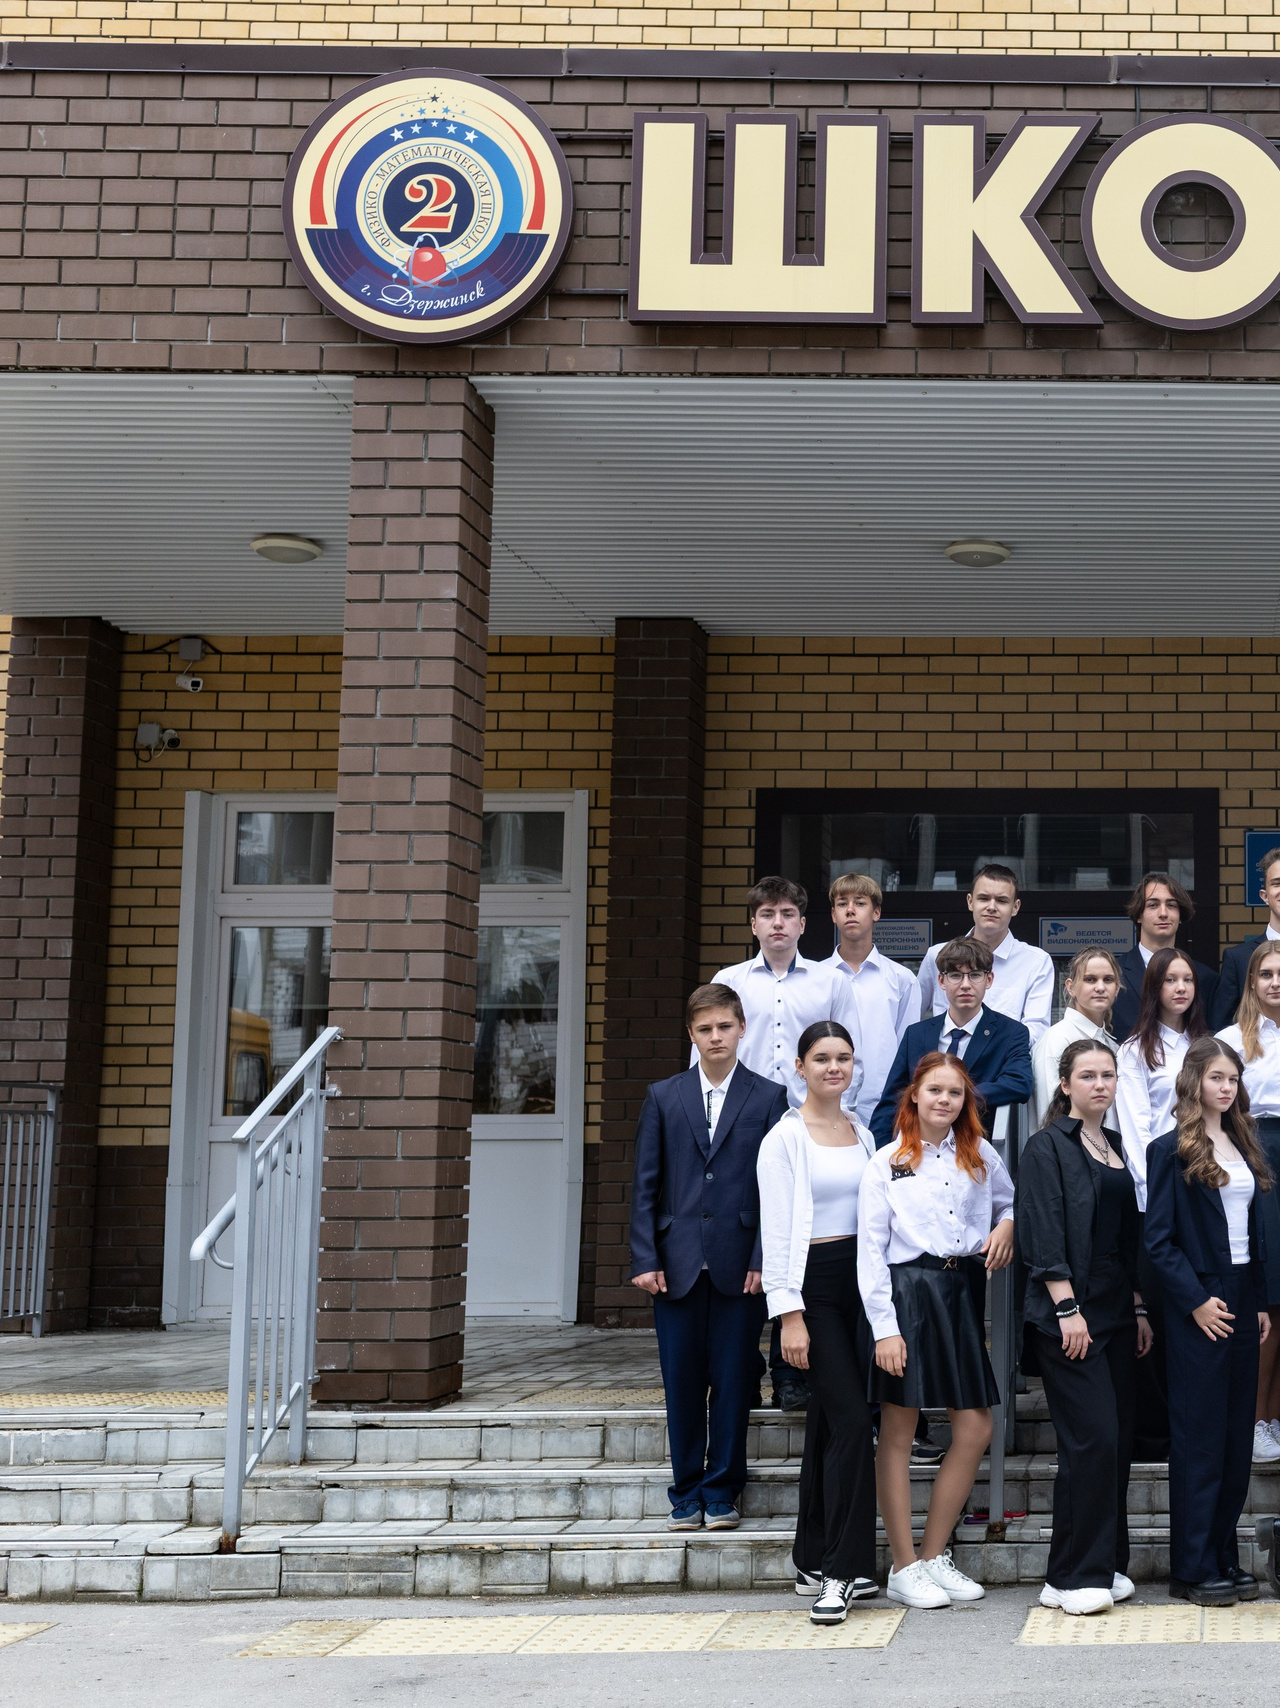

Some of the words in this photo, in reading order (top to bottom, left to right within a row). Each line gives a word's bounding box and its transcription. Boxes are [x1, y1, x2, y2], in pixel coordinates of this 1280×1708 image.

[376, 146, 492, 198] МАТЕМАТИЧЕСКАЯ
[366, 190, 391, 249] ФИЗИКО
[400, 173, 458, 233] 2
[461, 202, 493, 250] ШКОЛА
[376, 280, 486, 315] Дзержинск
